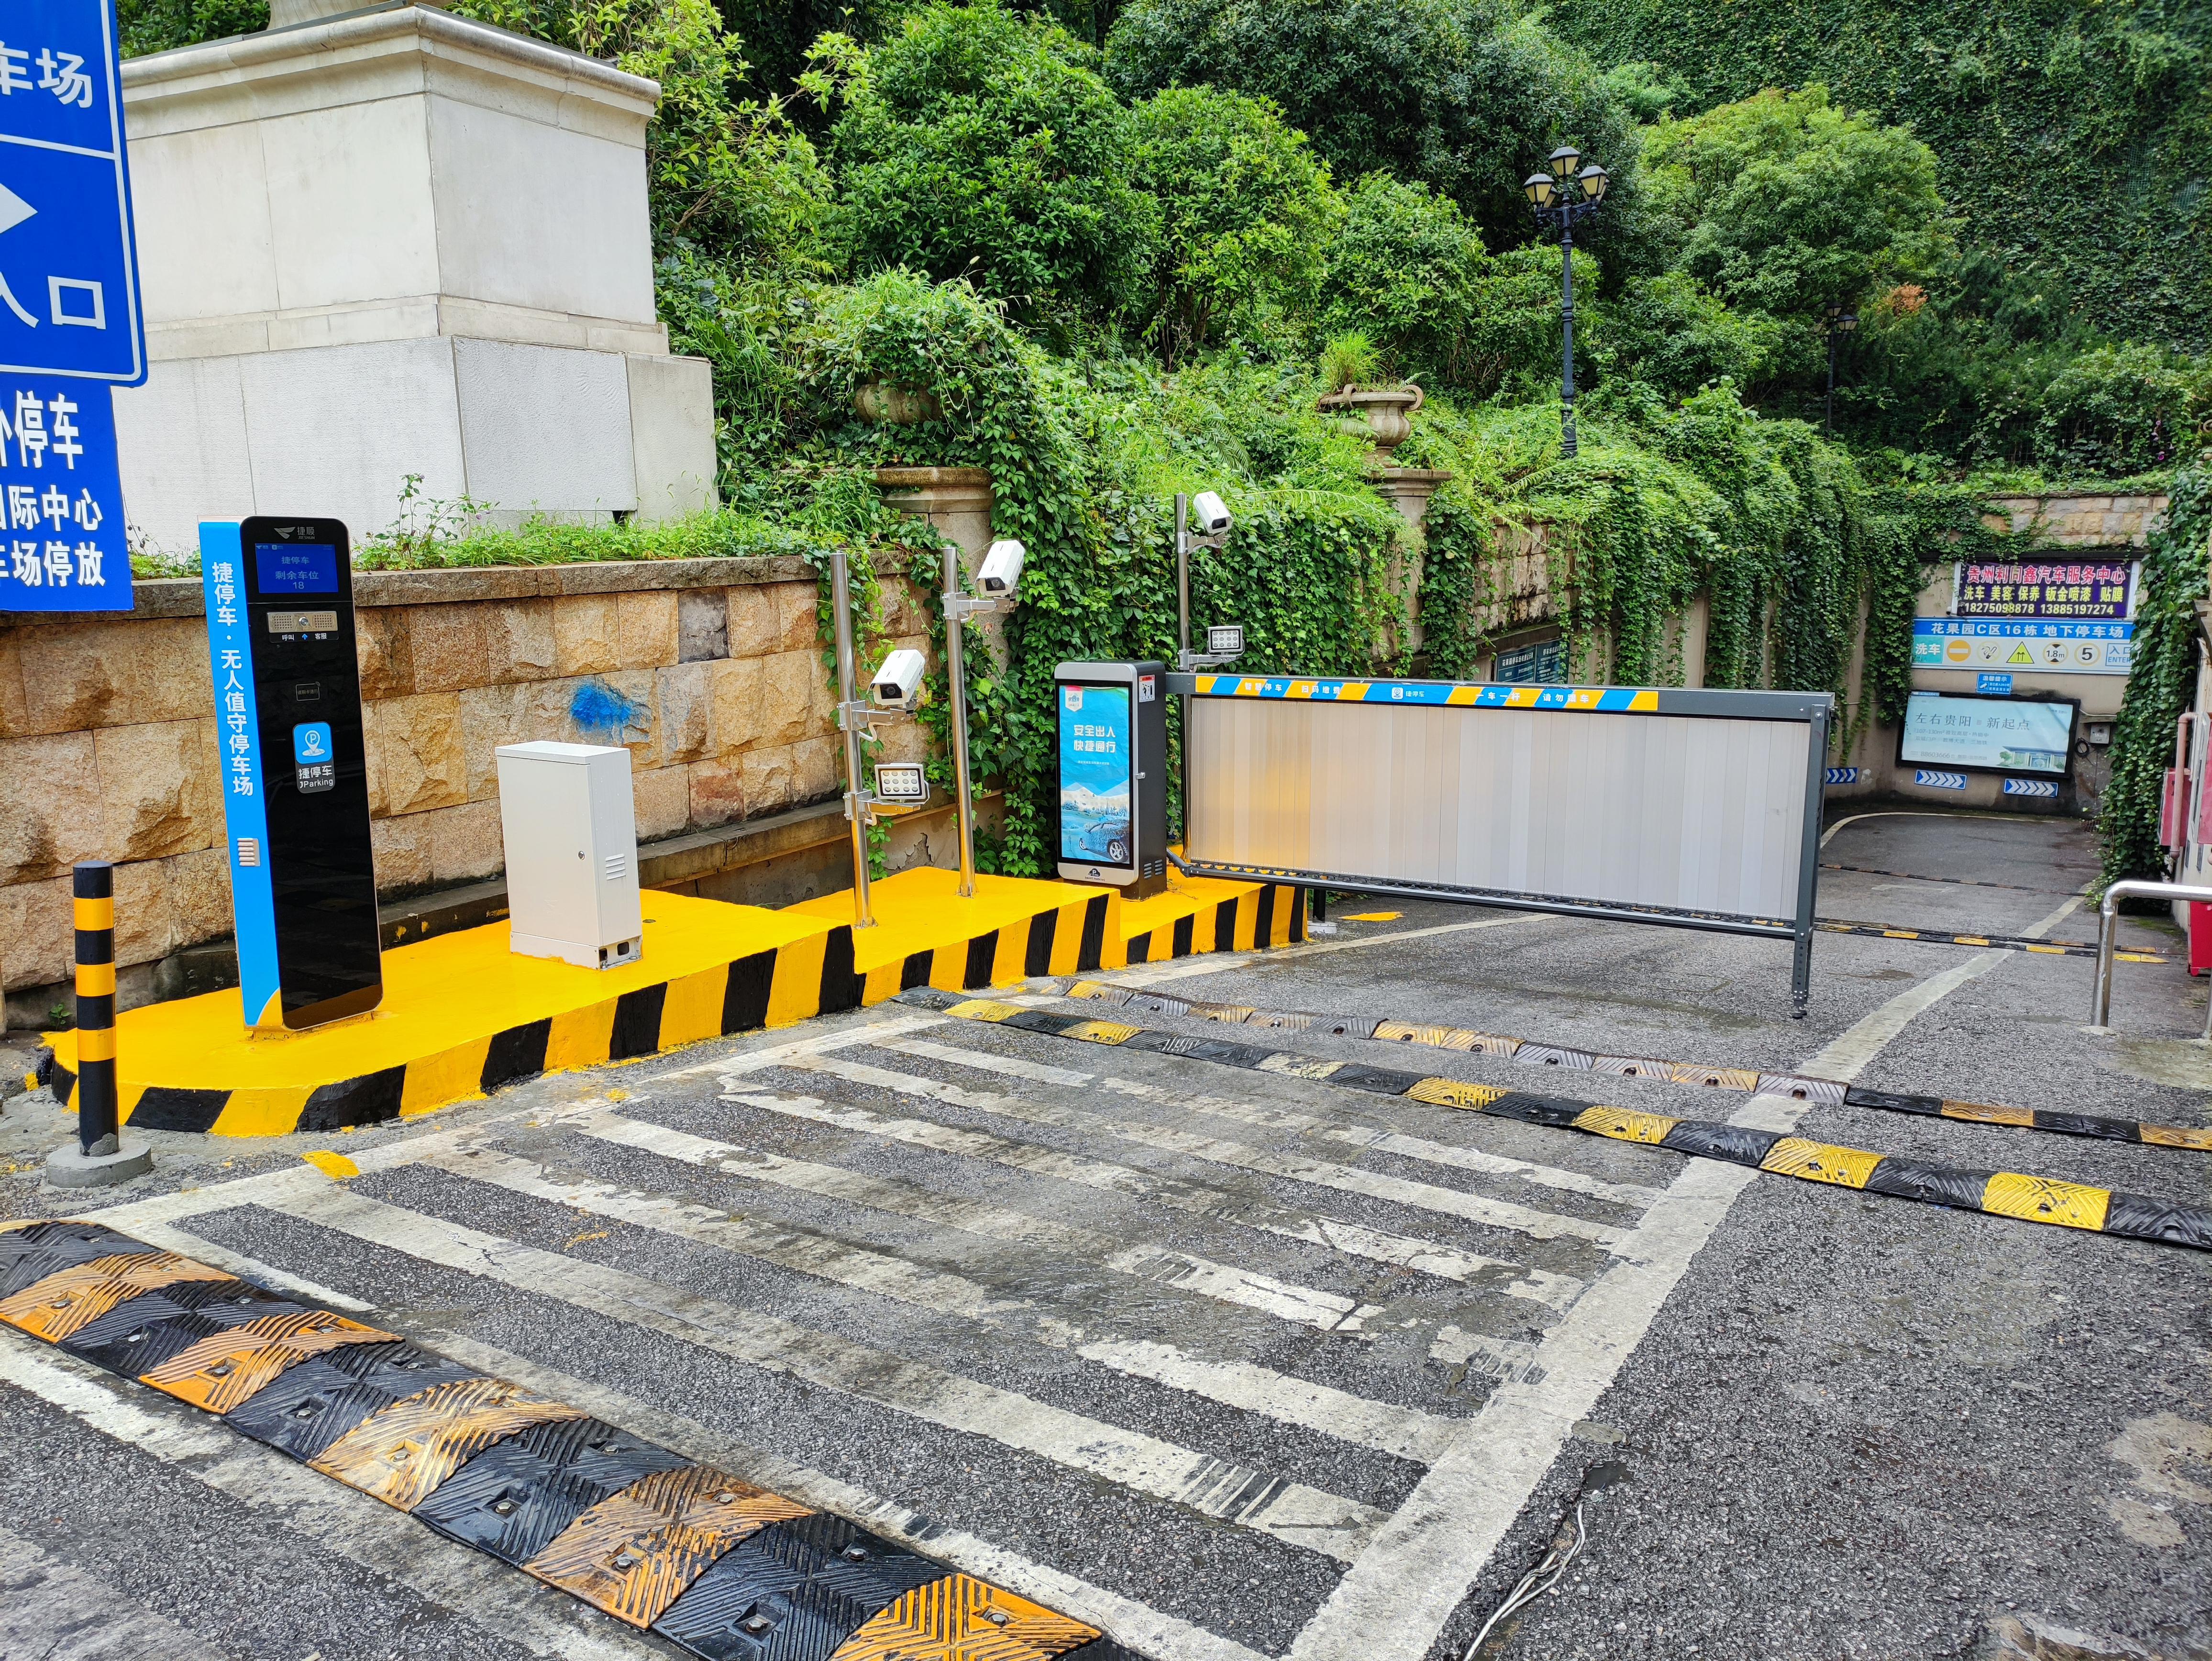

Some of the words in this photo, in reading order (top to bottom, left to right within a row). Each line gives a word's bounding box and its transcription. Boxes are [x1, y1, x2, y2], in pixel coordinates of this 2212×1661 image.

[0, 484, 103, 532] 际中心
[297, 526, 315, 535] 捷顺
[281, 556, 310, 565] 捷停车
[275, 571, 319, 580] 剩余车位
[293, 581, 304, 589] 18
[1964, 585, 1985, 601] 洗车
[1991, 585, 2013, 601] 美容
[2018, 586, 2040, 602] 保养
[2046, 586, 2091, 602] 钣金喷漆
[2100, 586, 2124, 603] 贴膜
[2040, 604, 2114, 615] 13885197274
[2043, 624, 2124, 638] 地下停车场
[1915, 643, 1941, 655] 洗车
[2046, 650, 2065, 658] 1.8m
[2081, 647, 2093, 661] 5
[1245, 682, 1282, 692] 智慧停车
[1301, 685, 1340, 694] 扫码缴费
[1476, 691, 1521, 701] 一车一杆
[1542, 693, 1589, 703] 请勿跟车
[1915, 712, 1971, 727] 左右贵阳
[1986, 717, 2030, 731] 新起点
[1073, 724, 1116, 738] 安全出入
[1073, 739, 1116, 753] 快捷通行
[298, 765, 332, 779] 捷停车
[299, 778, 333, 788] JParking
